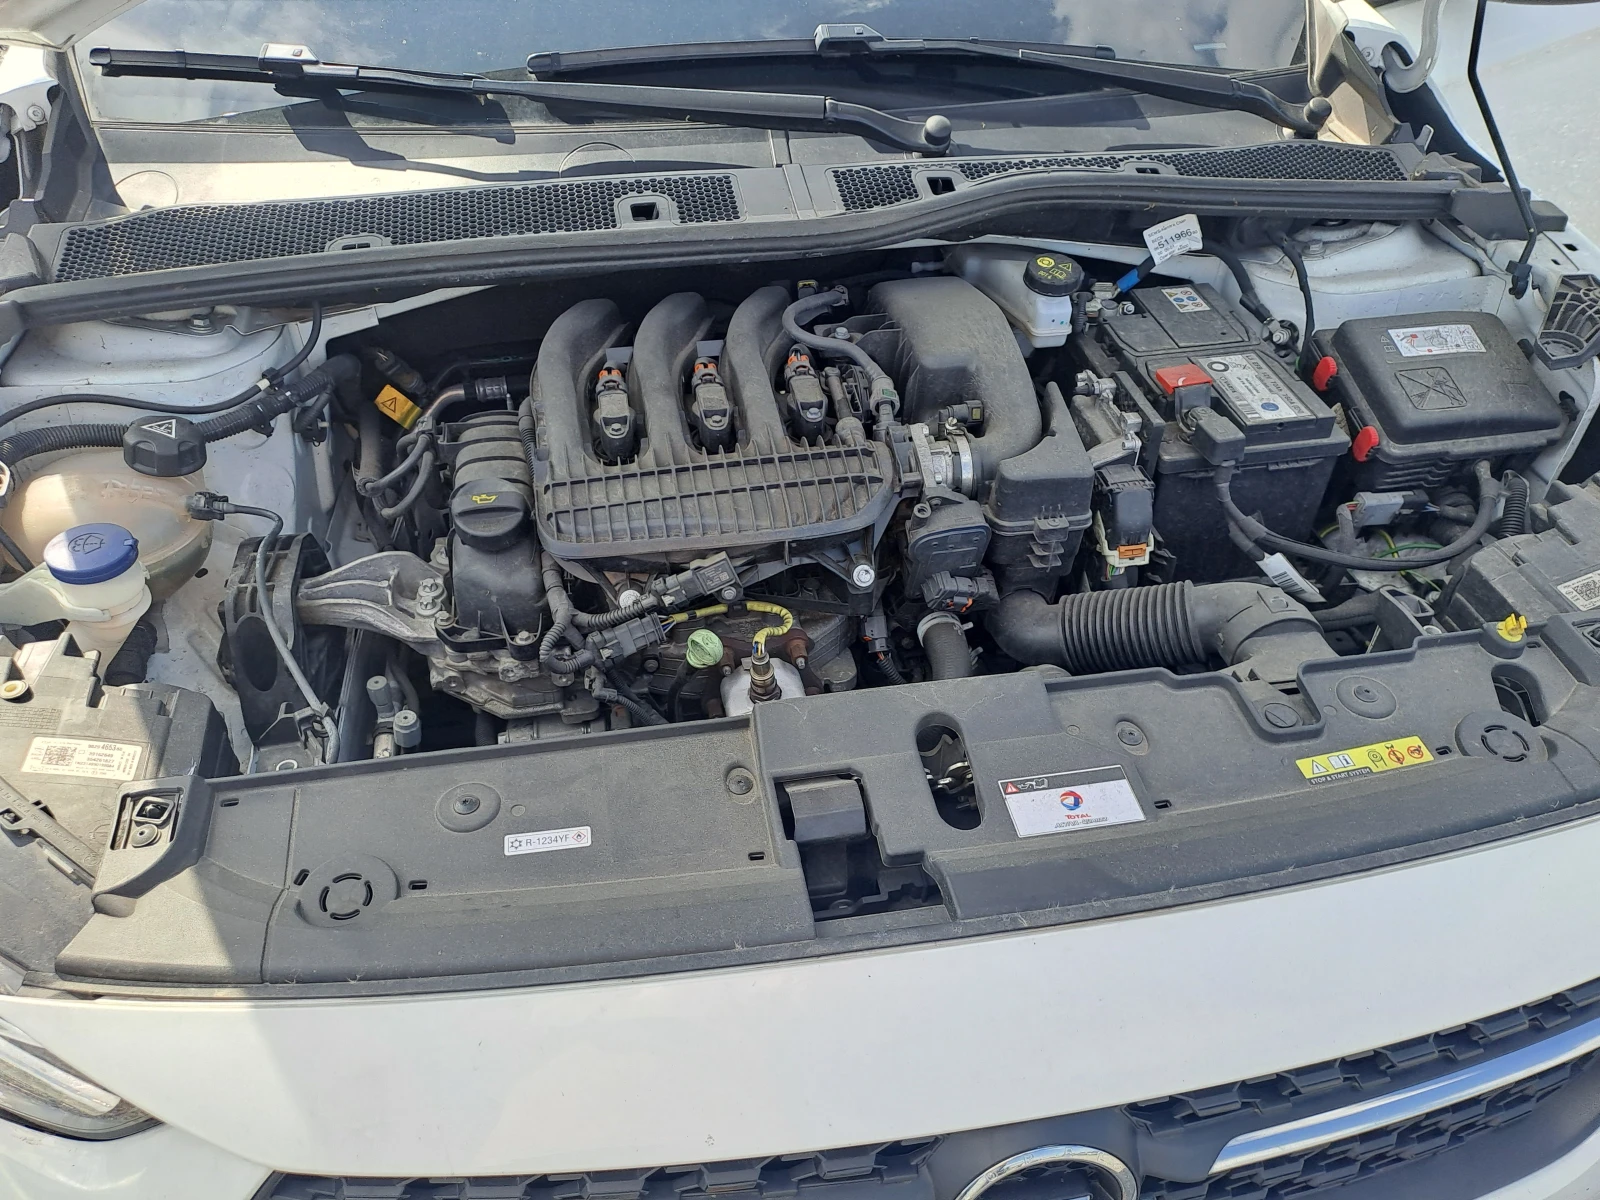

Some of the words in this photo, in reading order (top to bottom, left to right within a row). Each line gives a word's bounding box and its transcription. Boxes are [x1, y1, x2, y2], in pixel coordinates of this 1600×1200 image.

[101, 743, 117, 751] 4653
[1310, 776, 1326, 785] STOP
[1331, 771, 1349, 780] START
[1349, 767, 1371, 777] SYSTEM
[525, 833, 570, 847] R-1234YF
